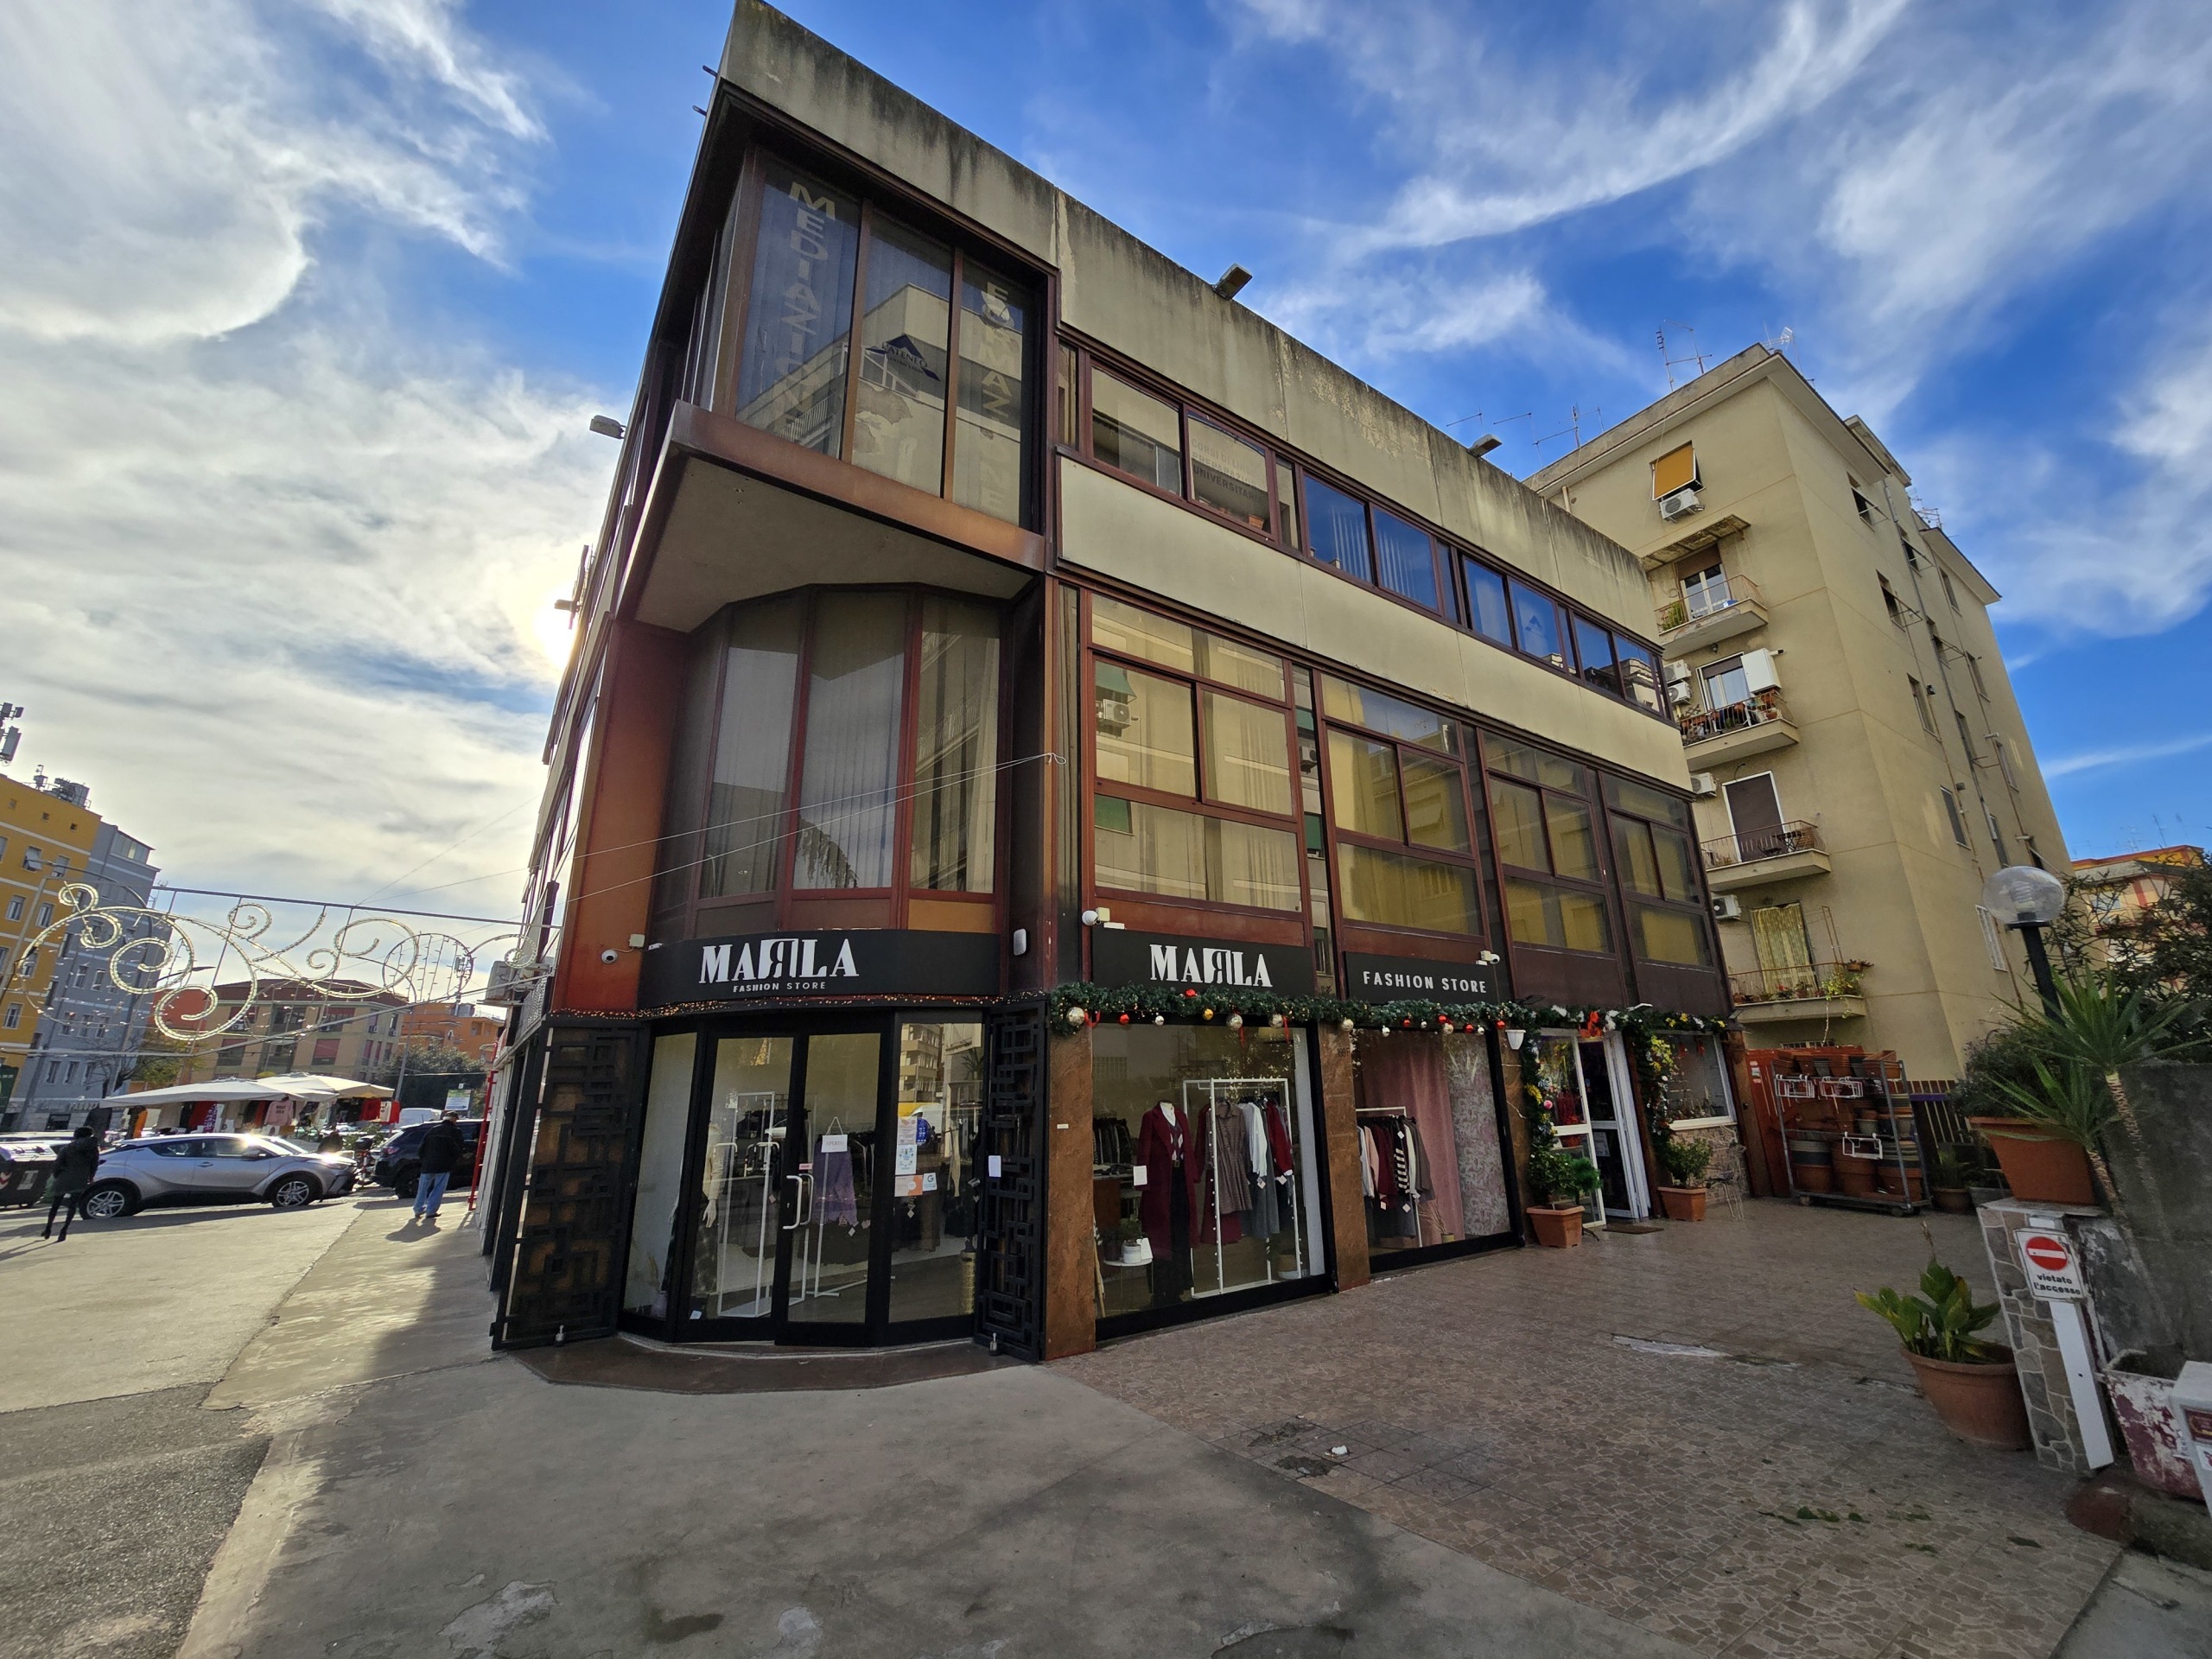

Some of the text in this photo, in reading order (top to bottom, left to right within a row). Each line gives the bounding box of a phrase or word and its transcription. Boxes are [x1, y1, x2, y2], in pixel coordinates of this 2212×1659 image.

[733, 982, 826, 993] FASHION STORE
[1363, 970, 1487, 994] FASHION STORE
[2037, 1273, 2073, 1285] vietato
